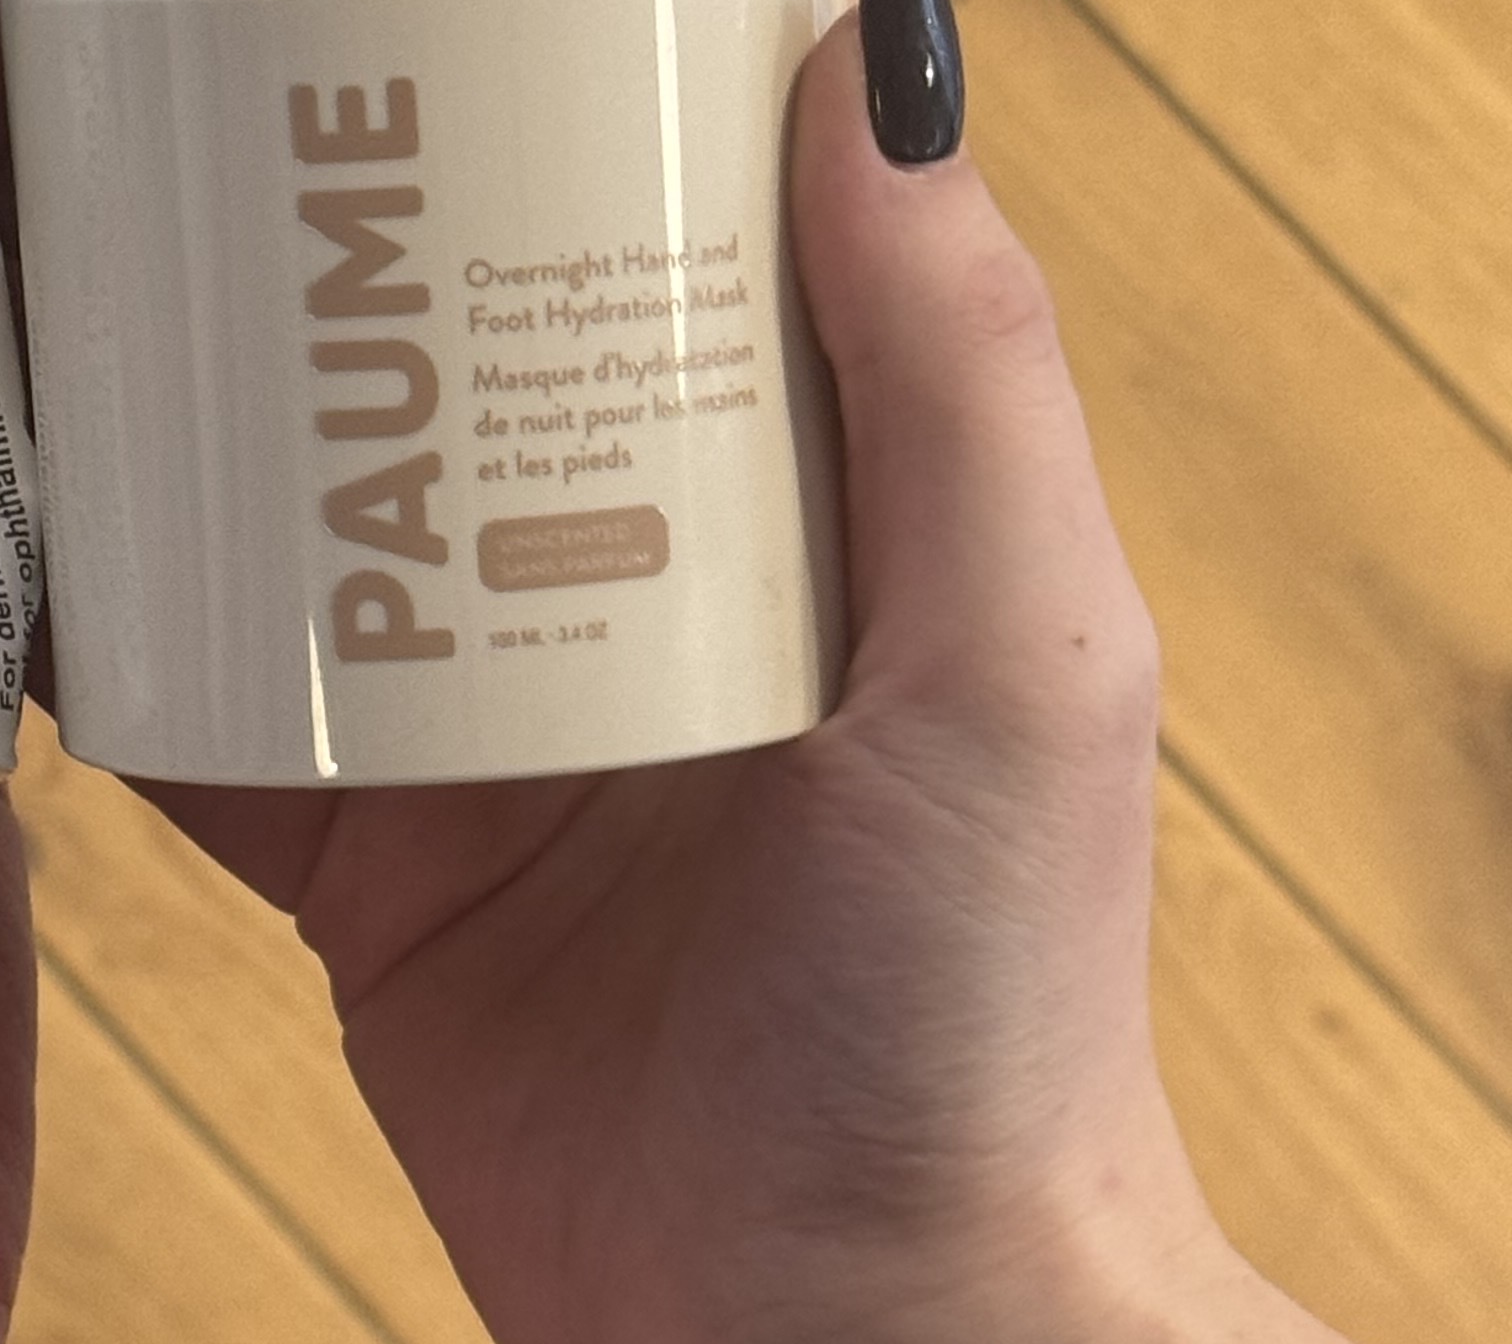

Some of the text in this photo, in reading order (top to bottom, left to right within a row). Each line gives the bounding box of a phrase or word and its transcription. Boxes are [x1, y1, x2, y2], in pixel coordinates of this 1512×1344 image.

[465, 233, 738, 291] Overnight Hand and
[469, 276, 749, 337] Foot Hydration Mask
[289, 77, 456, 662] PAUME
[472, 362, 586, 397] Masque
[474, 409, 509, 439] de
[519, 401, 576, 434] nuit
[585, 405, 646, 439] pour
[692, 382, 759, 413] mains
[477, 441, 633, 485] et les pieds
[0, 651, 19, 712] For
